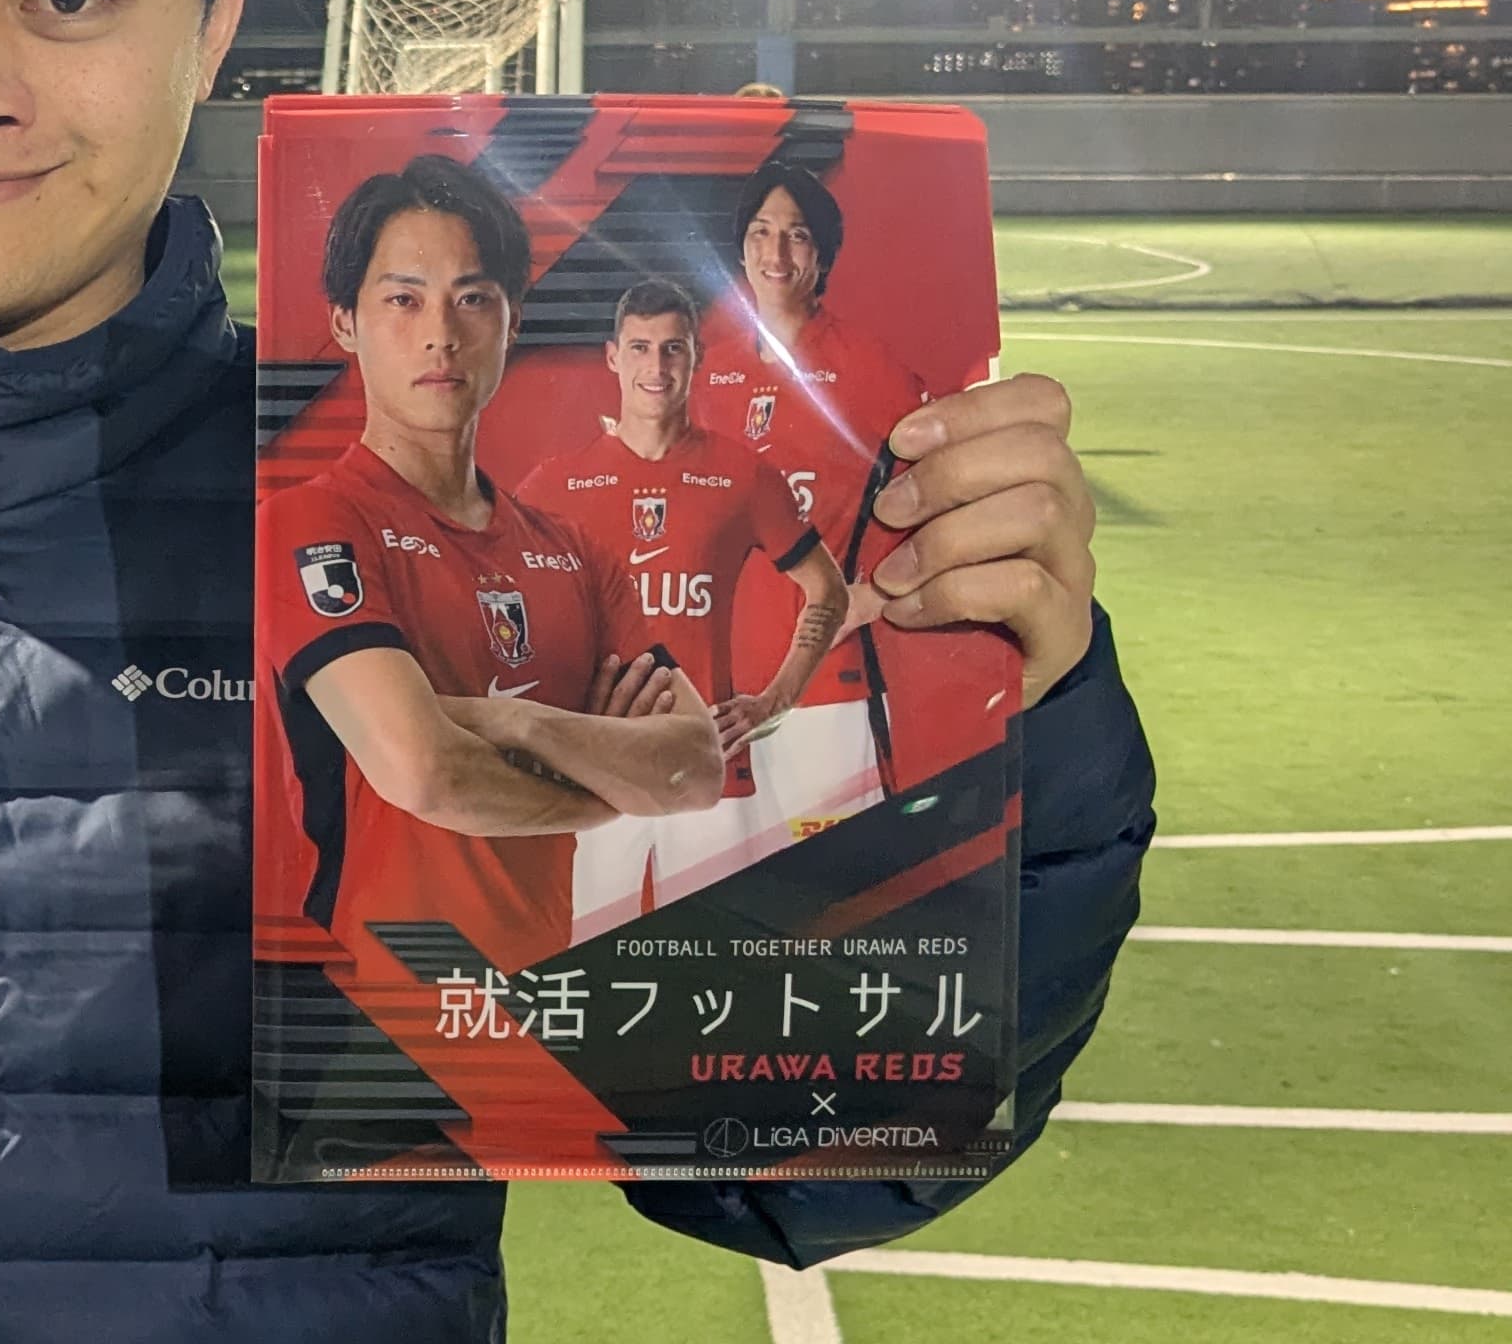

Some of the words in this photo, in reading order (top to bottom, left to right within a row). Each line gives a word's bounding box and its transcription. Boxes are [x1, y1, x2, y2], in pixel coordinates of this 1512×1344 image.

[629, 572, 713, 617] LUS
[155, 667, 257, 699] Colu
[616, 939, 717, 957] FOOTBALL
[730, 939, 832, 956] TOGETHER
[843, 938, 907, 956] URAWA
[918, 937, 968, 955] REDS
[435, 966, 982, 1040] 就活フットサル
[691, 1053, 836, 1081] URAWA
[855, 1052, 965, 1081] REDS
